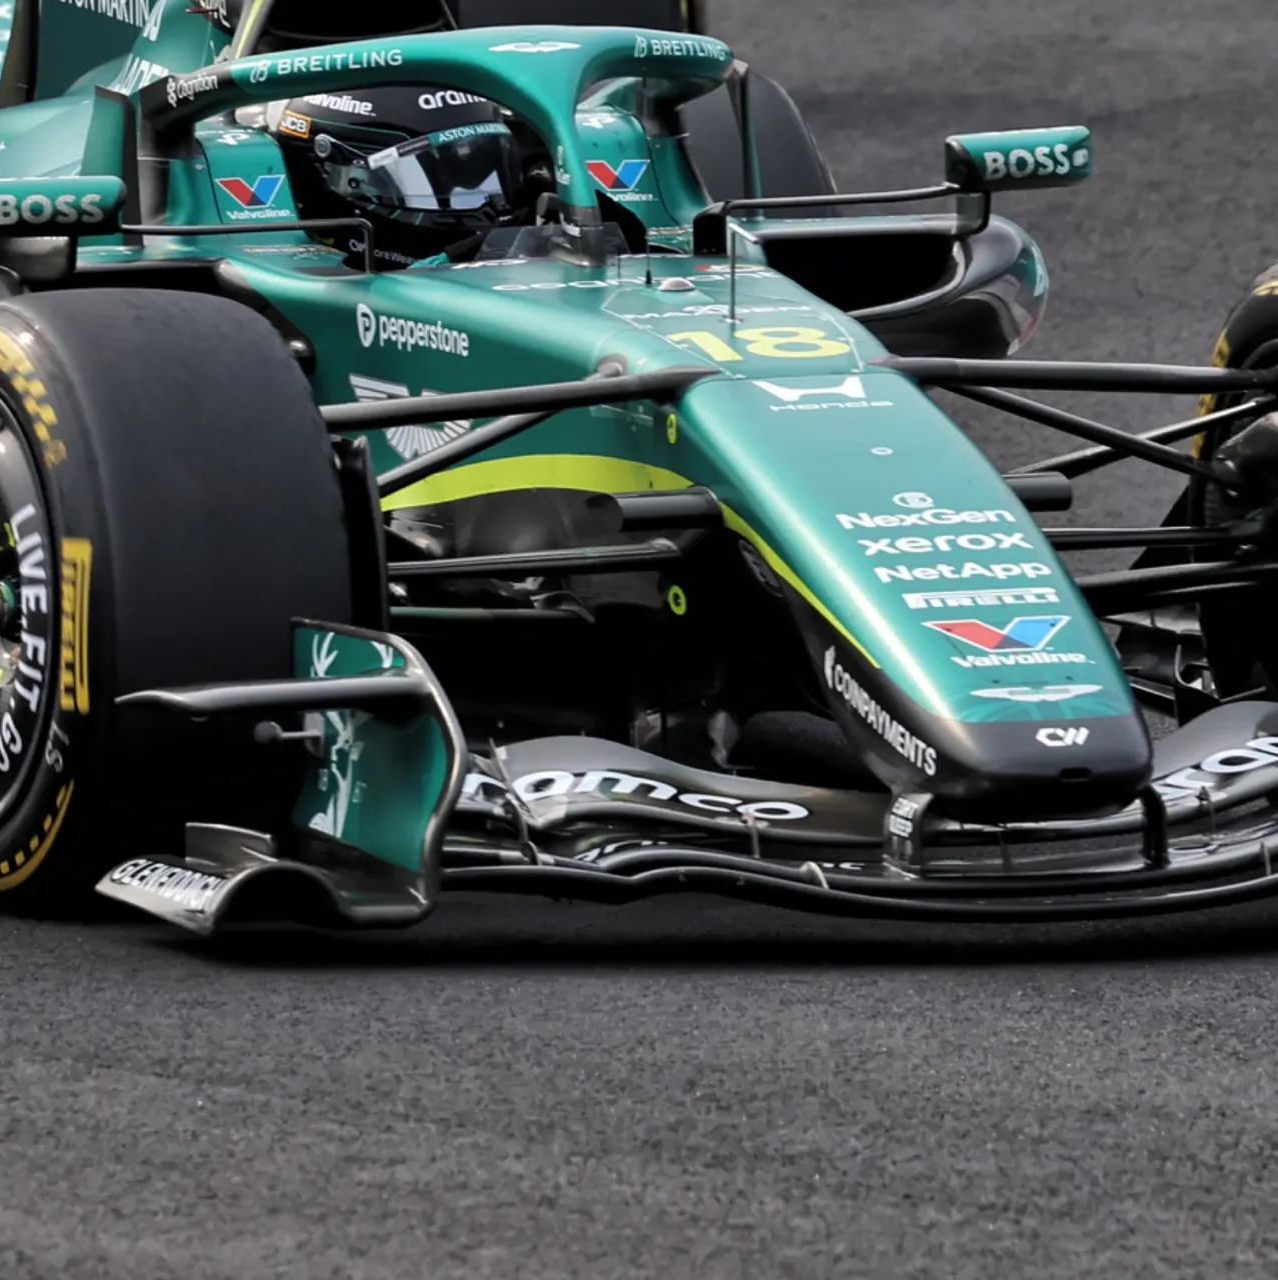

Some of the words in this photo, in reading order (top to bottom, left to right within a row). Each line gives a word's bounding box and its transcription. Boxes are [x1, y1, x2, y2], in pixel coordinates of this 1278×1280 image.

[651, 38, 726, 61] BREITLING
[277, 49, 403, 76] BREITLING
[438, 125, 476, 143] ASTON
[984, 144, 1070, 180] BOSS
[379, 315, 469, 357] pepperstone
[666, 326, 851, 363] 18
[835, 507, 1016, 529] NexGen
[858, 532, 1034, 556] xerox
[874, 560, 1052, 583] NetApp
[901, 587, 1060, 609] PIRELLI
[950, 652, 1088, 668] Valvoline
[834, 664, 937, 776] COINPAYMENTS
[462, 770, 809, 820] ramco
